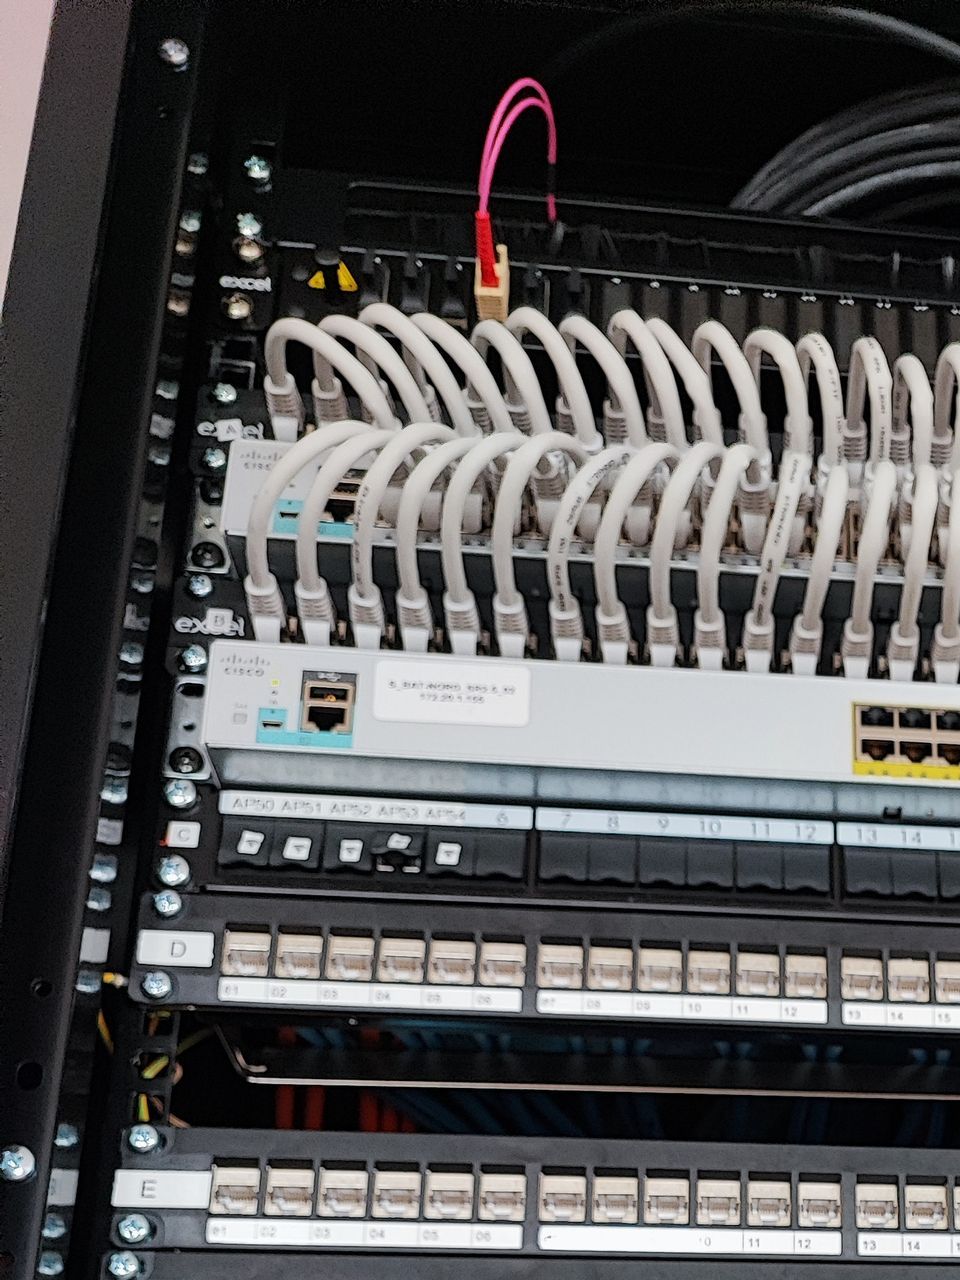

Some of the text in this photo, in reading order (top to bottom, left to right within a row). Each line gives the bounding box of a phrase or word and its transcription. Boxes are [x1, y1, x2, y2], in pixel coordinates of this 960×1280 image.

[563, 813, 817, 840] 7 8 9 10 11 12
[178, 828, 191, 843] C
[857, 827, 878, 842] 13
[901, 830, 922, 845] 14
[170, 941, 187, 959] D
[141, 1179, 158, 1199] E
[369, 1228, 386, 1239] 04
[475, 1231, 492, 1242] 06
[749, 1237, 761, 1248] 11
[797, 1238, 812, 1249] 12
[862, 1240, 877, 1251] 13
[907, 1240, 921, 1251] 14
